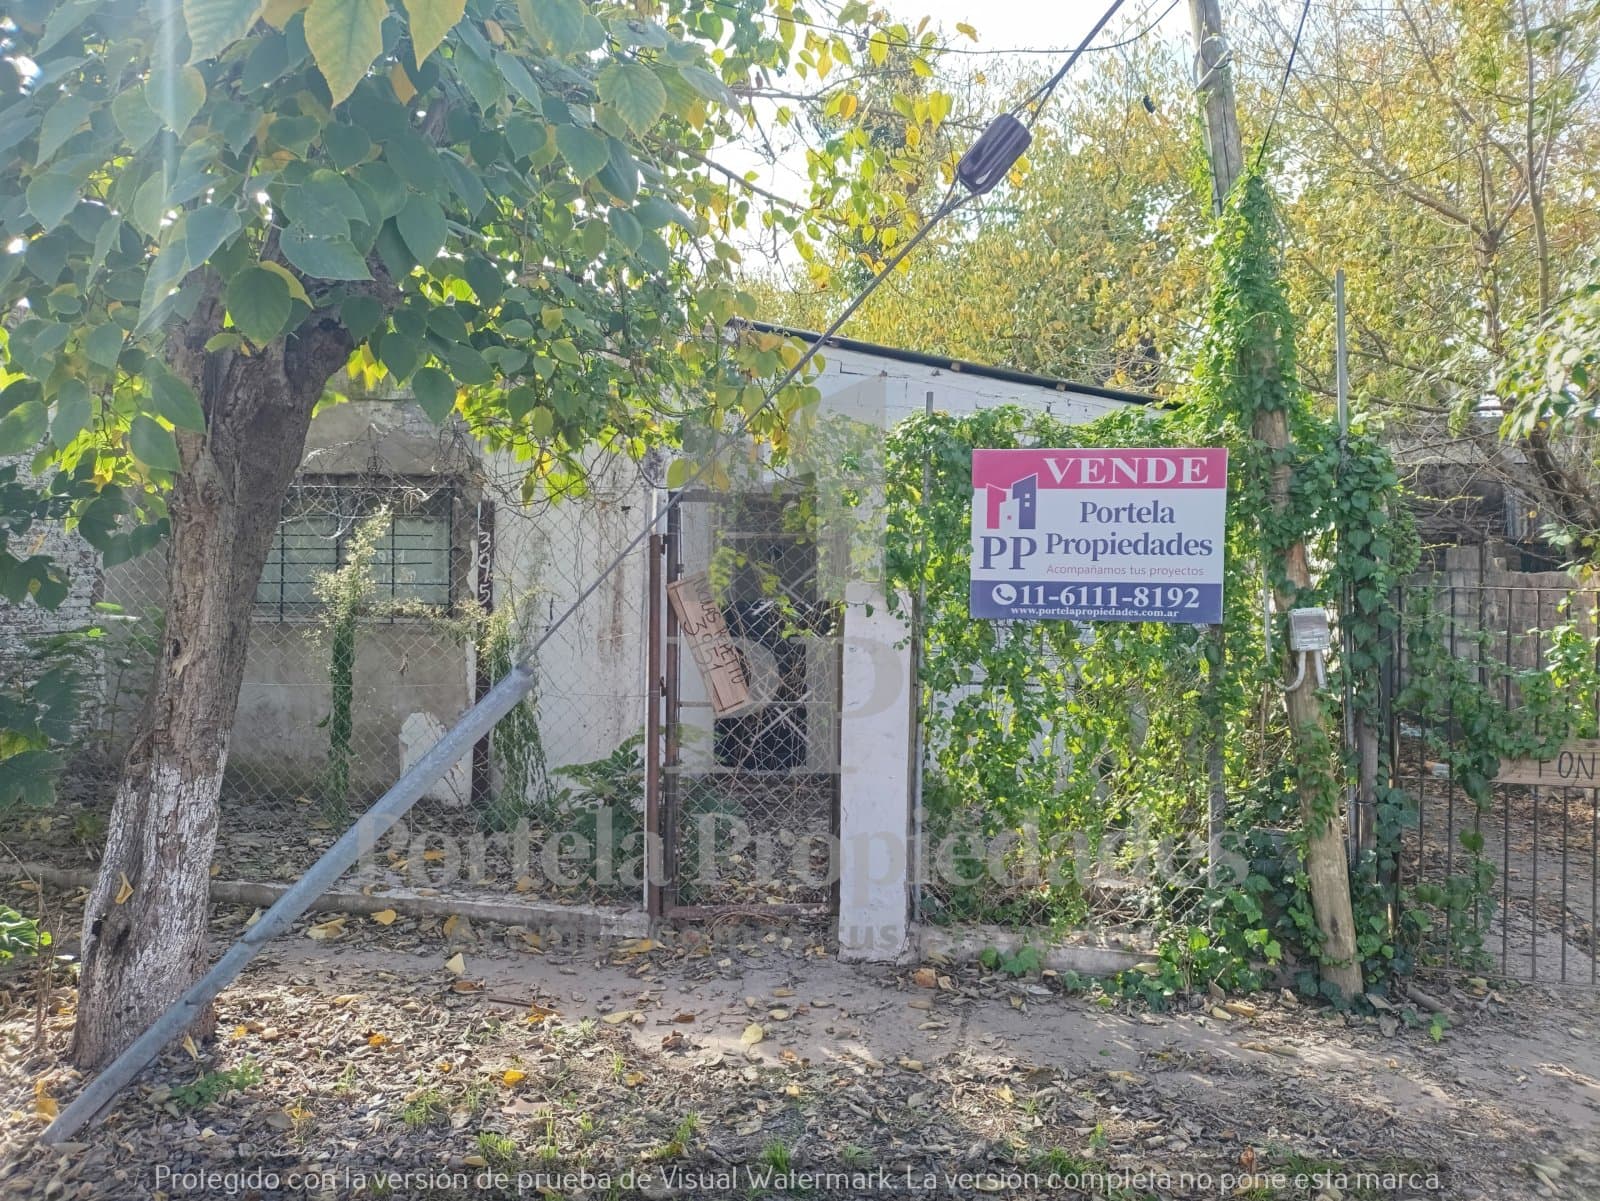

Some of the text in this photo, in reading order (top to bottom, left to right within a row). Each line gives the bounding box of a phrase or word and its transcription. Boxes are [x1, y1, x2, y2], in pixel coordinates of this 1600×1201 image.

[1043, 456, 1209, 485] VENDE
[1079, 499, 1176, 524] Portela
[979, 535, 1038, 570] PP
[1046, 532, 1213, 562] Propiedades
[1046, 563, 1205, 578] Acompañamos tus proyectos
[1020, 585, 1200, 609] 11-6111-8192
[1010, 606, 1179, 618] www.portelapropiedades.com.ar
[682, 616, 725, 673] 3951
